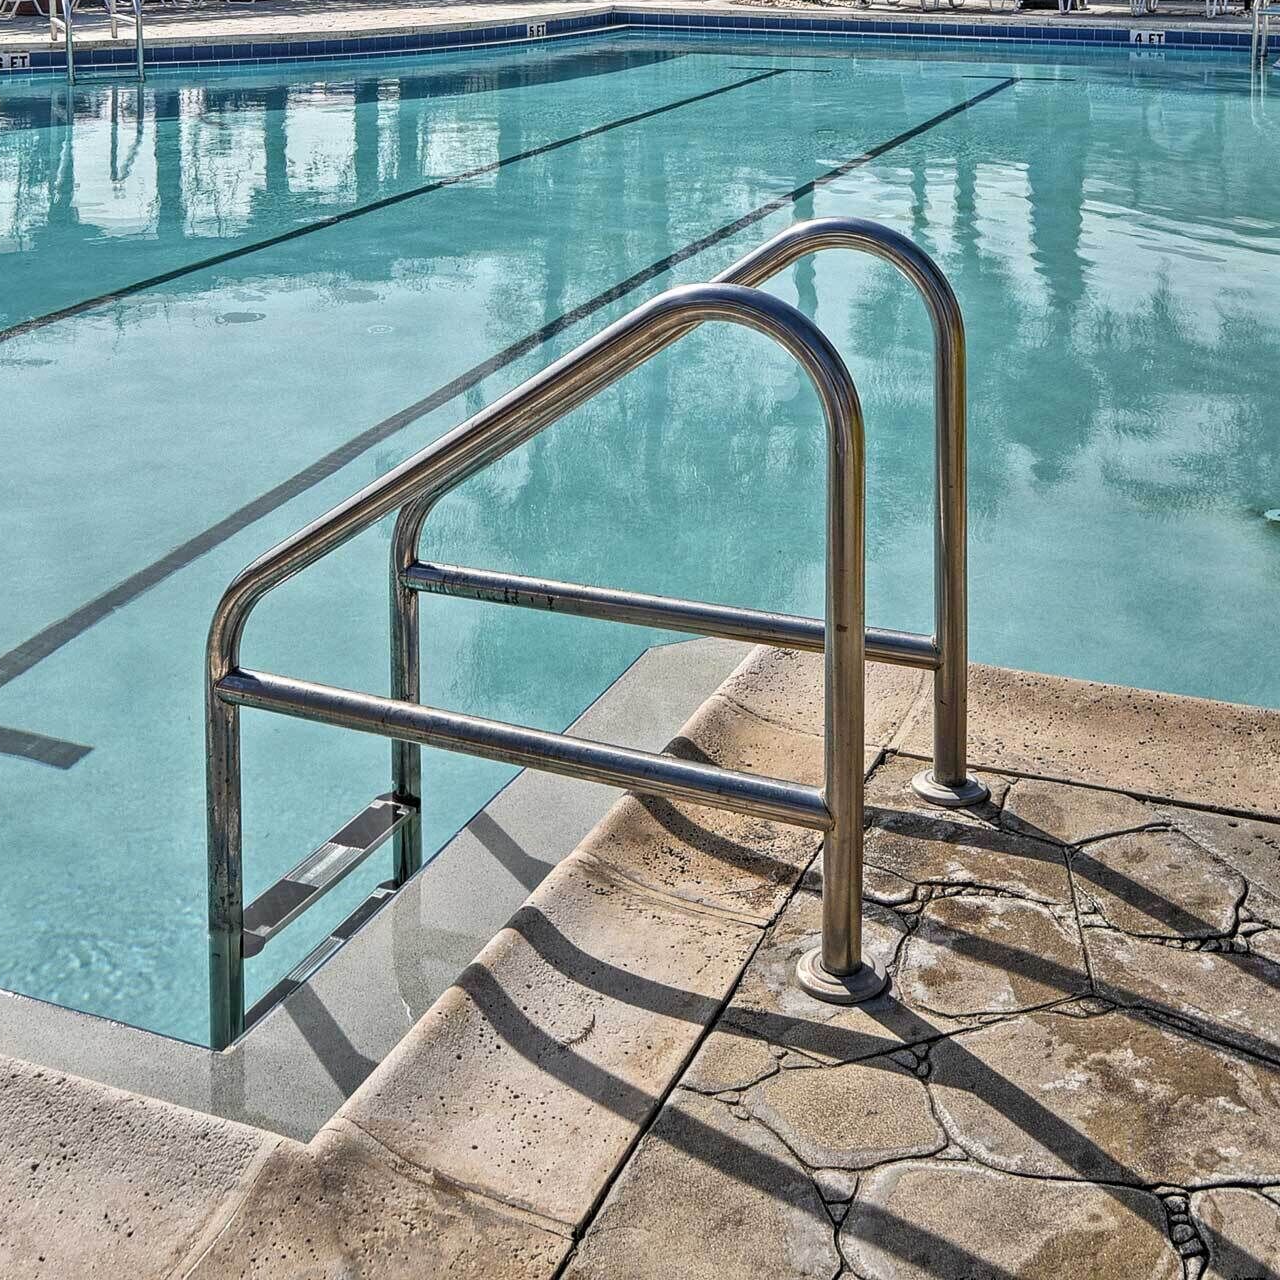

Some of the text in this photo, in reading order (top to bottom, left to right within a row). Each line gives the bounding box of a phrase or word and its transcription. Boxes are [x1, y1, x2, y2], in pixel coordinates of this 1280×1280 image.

[536, 24, 545, 37] FT
[1134, 32, 1164, 44] 4 FT
[10, 55, 28, 68] FT
